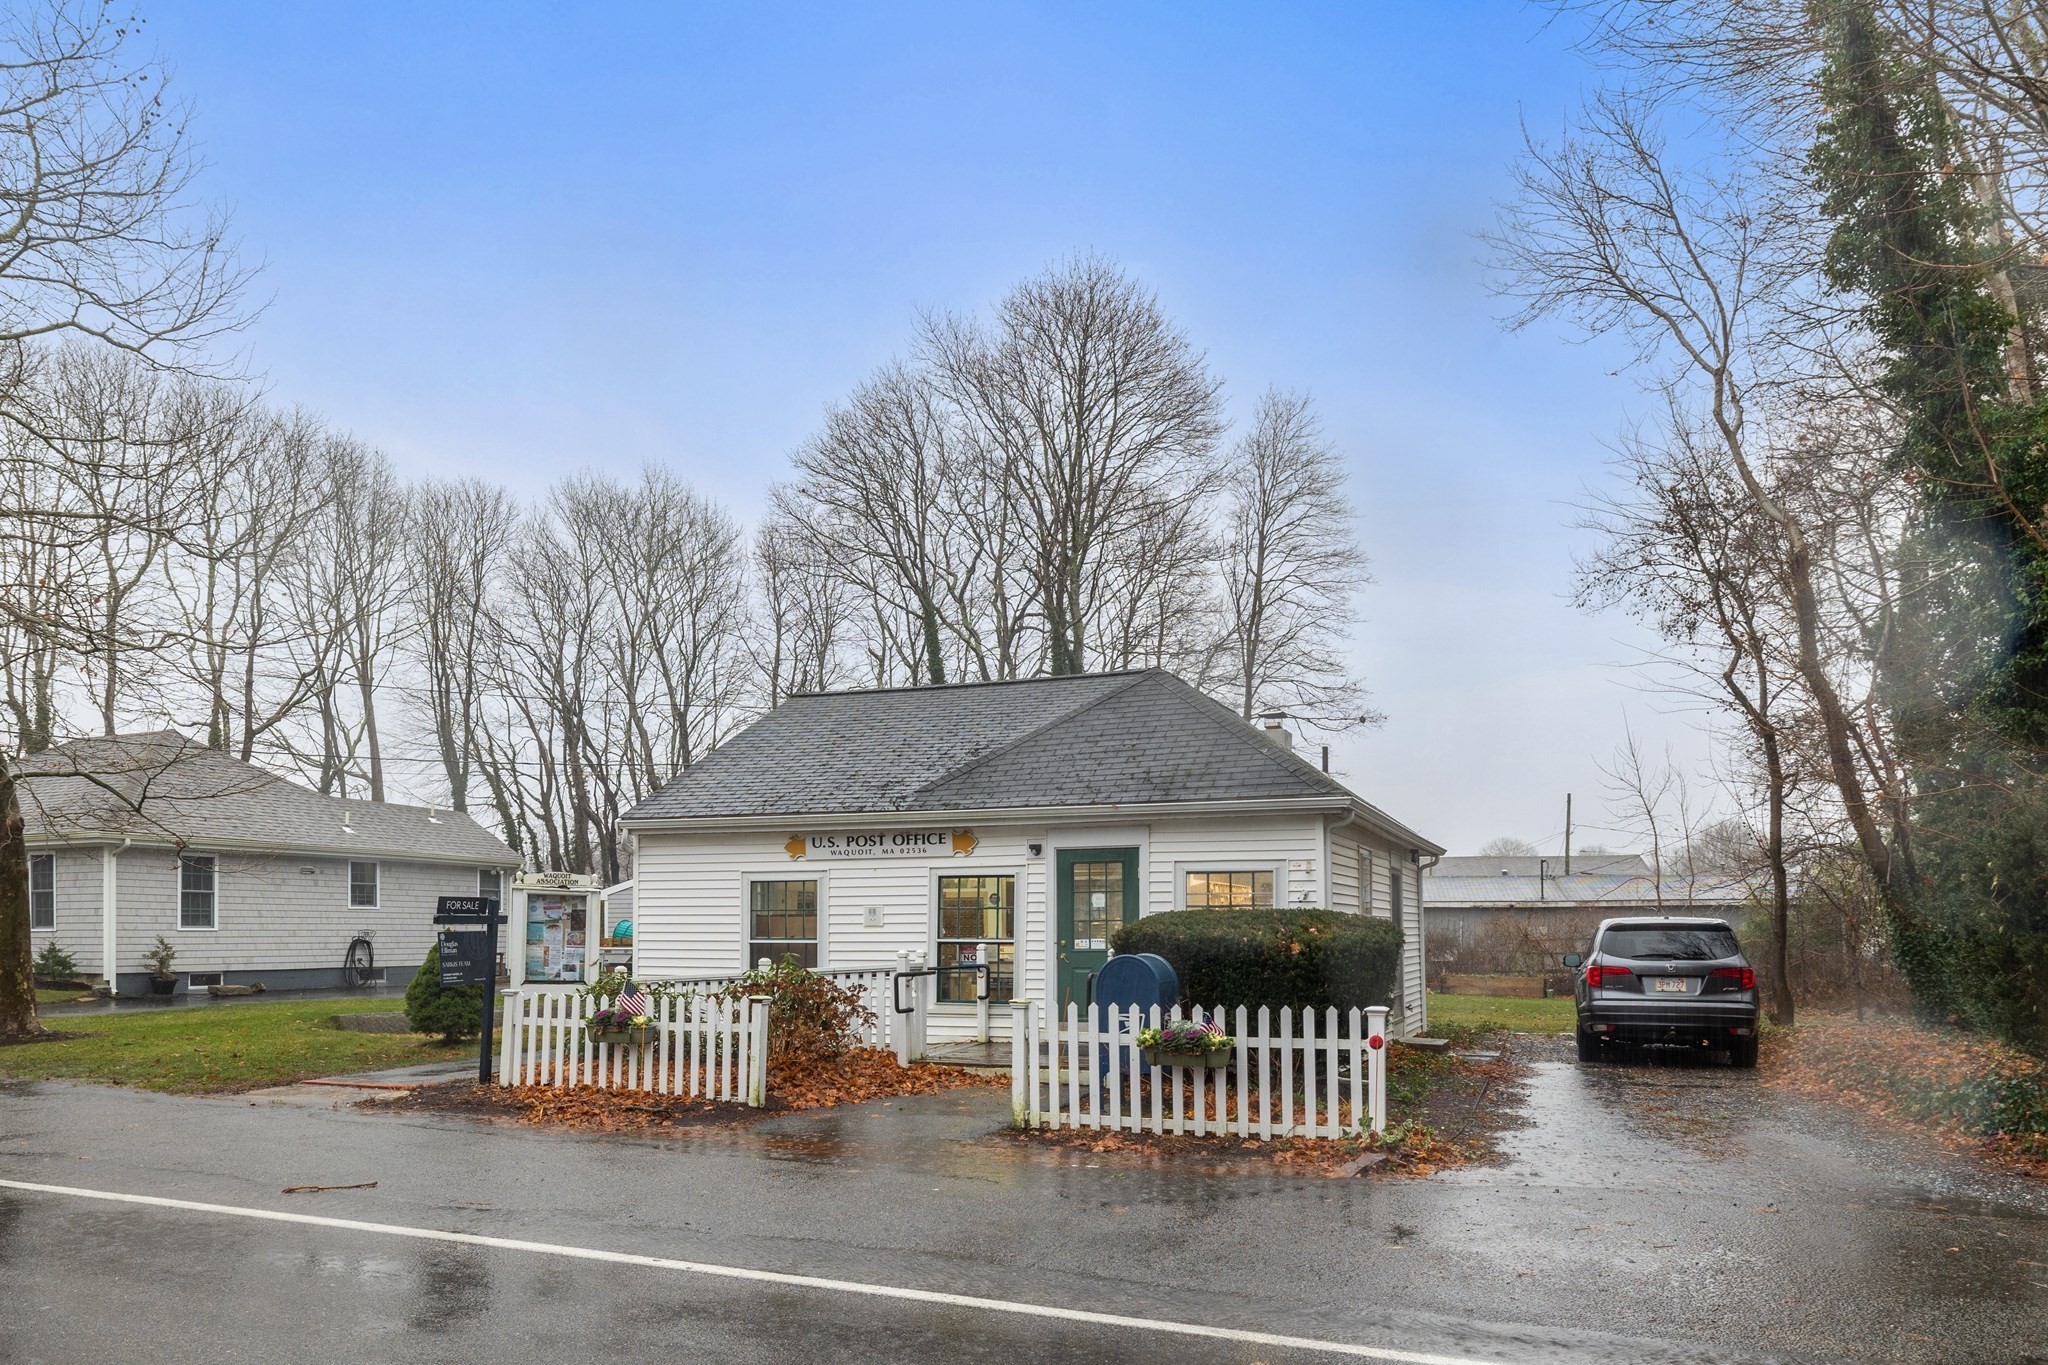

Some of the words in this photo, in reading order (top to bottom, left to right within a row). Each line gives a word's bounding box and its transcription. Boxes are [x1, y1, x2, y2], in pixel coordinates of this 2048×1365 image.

[812, 836, 840, 849] U.S.
[846, 834, 886, 848] POST
[892, 832, 947, 847] OFFICE
[830, 848, 876, 857] WAQUOIT,
[882, 847, 895, 855] MA
[899, 847, 927, 855] 02536
[446, 900, 461, 910] FOR
[462, 900, 480, 910] SALE
